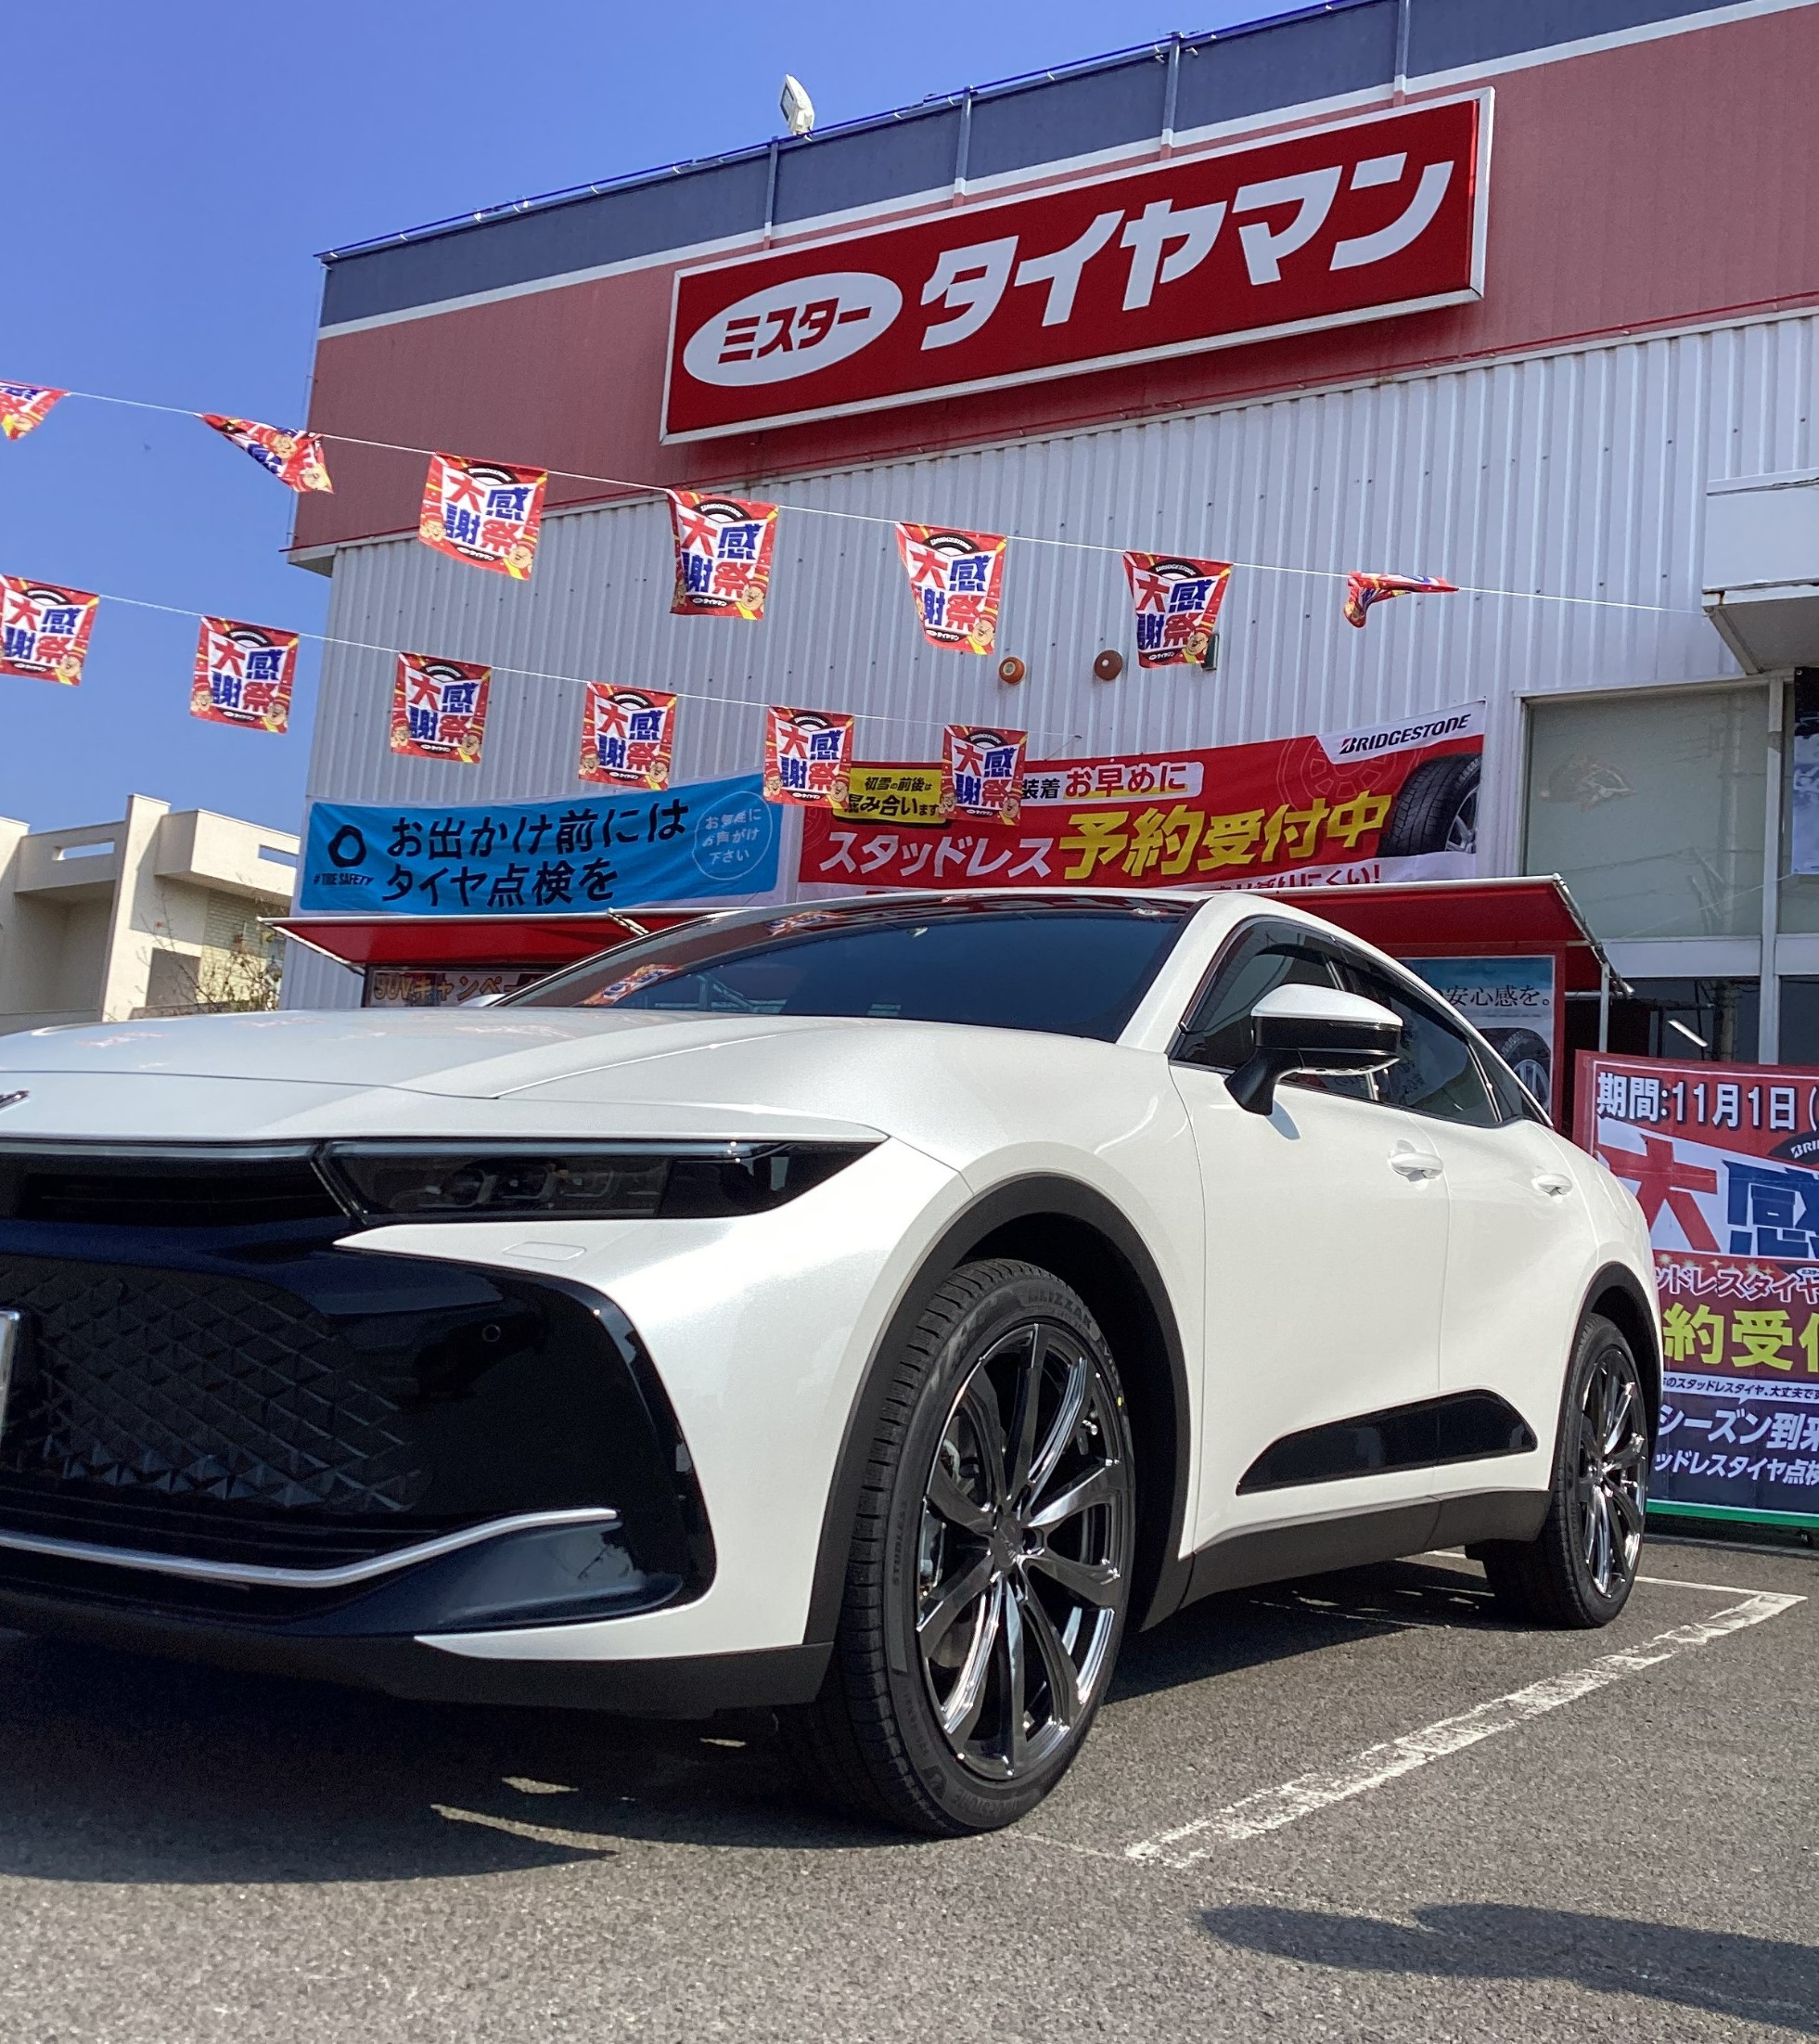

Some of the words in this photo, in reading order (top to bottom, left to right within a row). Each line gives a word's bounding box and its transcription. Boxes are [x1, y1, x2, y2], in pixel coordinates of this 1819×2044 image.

[718, 296, 874, 366] ミスター
[920, 151, 1455, 352] タイヤマン
[445, 474, 533, 521] 大感
[679, 514, 763, 560] 大感
[910, 548, 993, 593] 大感
[1135, 574, 1216, 613] 大感
[4, 598, 84, 636] 大感
[211, 640, 286, 681] 大感
[408, 675, 479, 713] 大感
[596, 704, 665, 741] 大感
[1340, 713, 1472, 756] BRIDGESTONE
[778, 726, 844, 761] 大感
[954, 743, 1018, 778] 大感
[1064, 764, 1188, 798] お早めに
[387, 798, 689, 861] お出かけ前には
[819, 830, 1056, 880] スタッドレス
[1058, 793, 1392, 880] 予約受付中
[709, 848, 750, 865] 下さい
[382, 856, 619, 907] タイヤ点検を
[1437, 983, 1550, 1008] 安心感を。
[1791, 1138, 1819, 1159] BRI
